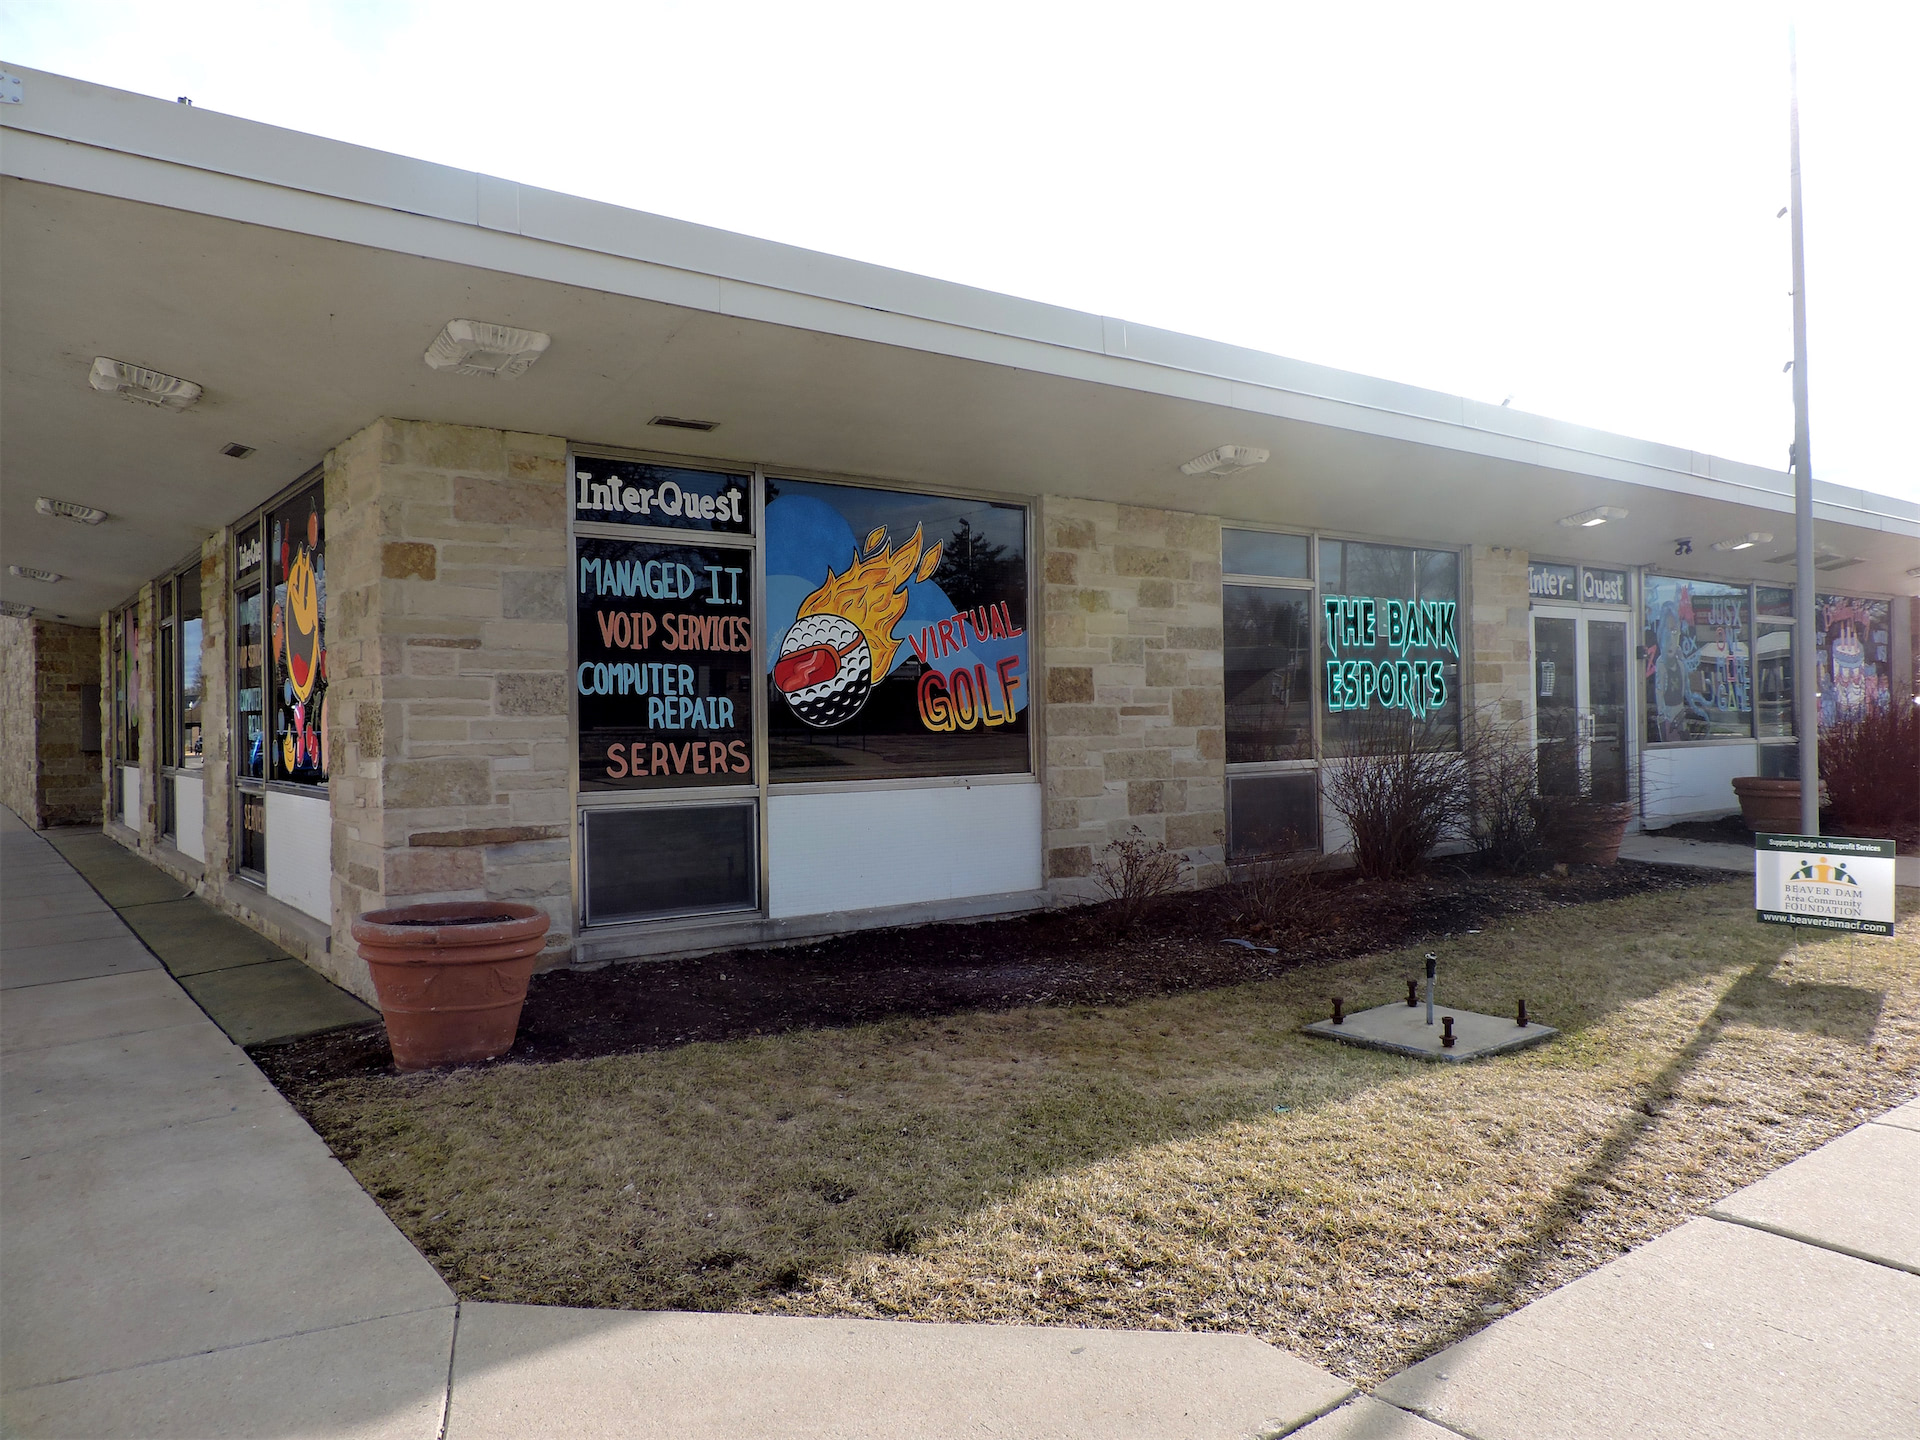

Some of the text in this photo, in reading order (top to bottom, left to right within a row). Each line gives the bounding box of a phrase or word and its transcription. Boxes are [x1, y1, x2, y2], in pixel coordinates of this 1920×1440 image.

[576, 471, 742, 523] Inter-Quest
[580, 557, 743, 605] MANAGED I.T.
[1583, 571, 1624, 601] Quest
[597, 610, 751, 651] VOIP SERVICES
[908, 601, 1023, 664] VIRTUAL
[1325, 599, 1460, 658] THE BANK
[577, 661, 694, 696] COMPUTER
[917, 655, 1021, 732] GOLF
[1326, 660, 1446, 722] ESPORTS
[648, 696, 735, 730] REPAIR
[606, 740, 750, 779] SERVERS
[1768, 839, 1799, 848] Supporting
[1799, 841, 1818, 849] Dodge
[1828, 842, 1855, 851] Nonprofit
[1855, 844, 1881, 852] Services
[1784, 894, 1862, 909] Area Community
[1785, 884, 1862, 898] BEAVER DAM
[1785, 902, 1862, 917] FOUNDATION
[1763, 912, 1887, 933] www.beaverdamacf.com
